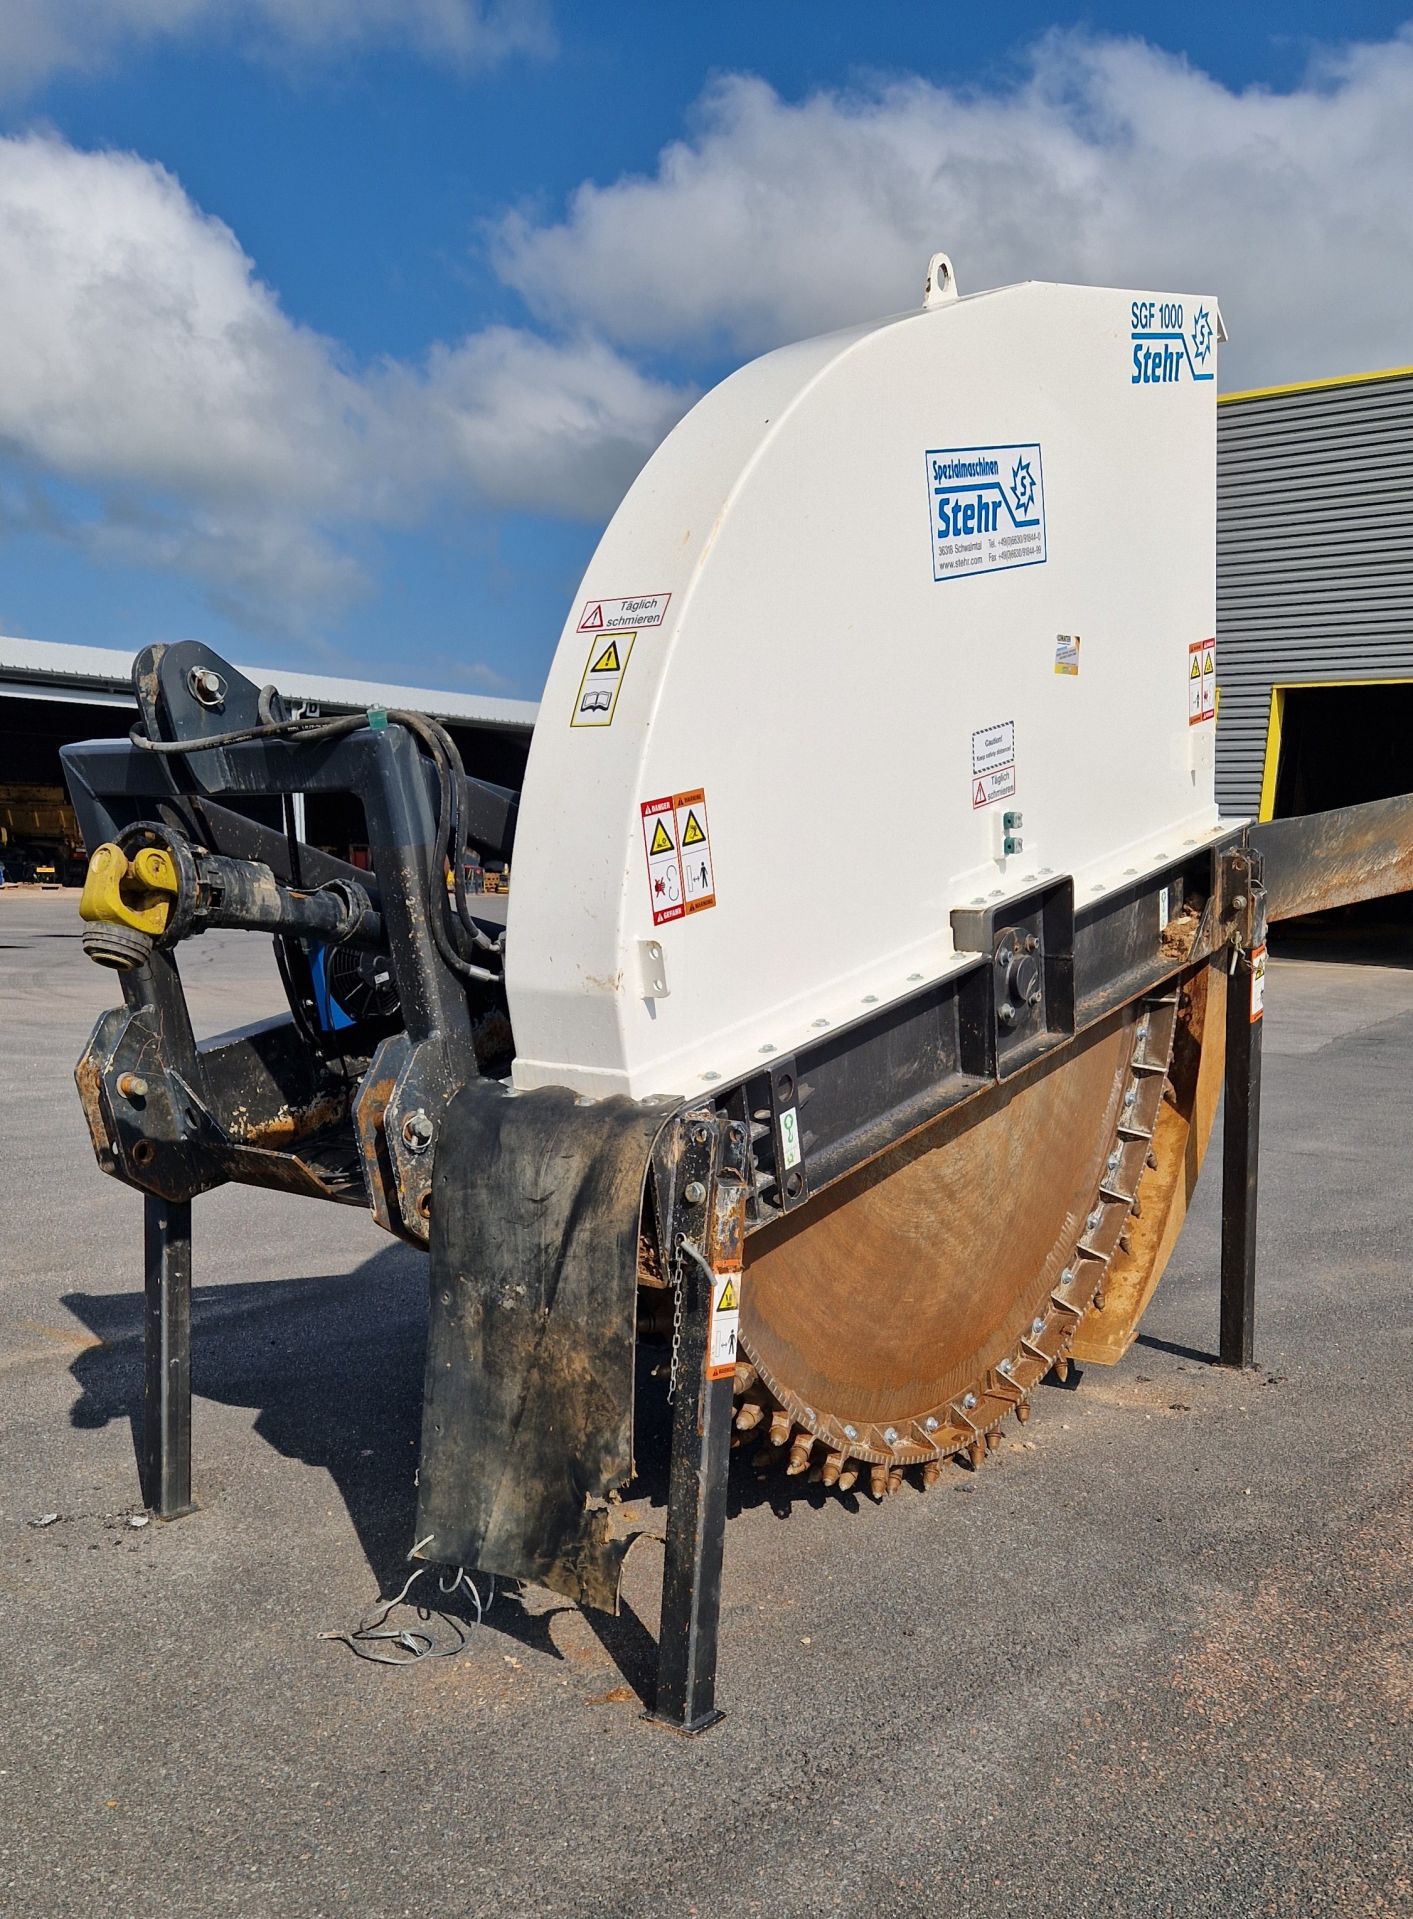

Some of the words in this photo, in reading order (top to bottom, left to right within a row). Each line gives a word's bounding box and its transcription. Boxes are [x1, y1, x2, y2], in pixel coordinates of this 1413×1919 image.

[1131, 302, 1155, 329] SGF
[1159, 303, 1183, 329] 1000
[1131, 343, 1184, 384] Stehr
[932, 457, 999, 485] Spezialmaschinen
[938, 494, 1002, 539] Stehr
[939, 556, 983, 570] www.stehr.com
[620, 599, 658, 612] Täglich
[606, 613, 660, 627] schmieren
[985, 735, 1002, 747] Caution!
[991, 771, 1009, 785] Täglich
[987, 784, 1014, 801] schmieren
[651, 801, 671, 813] DANGER
